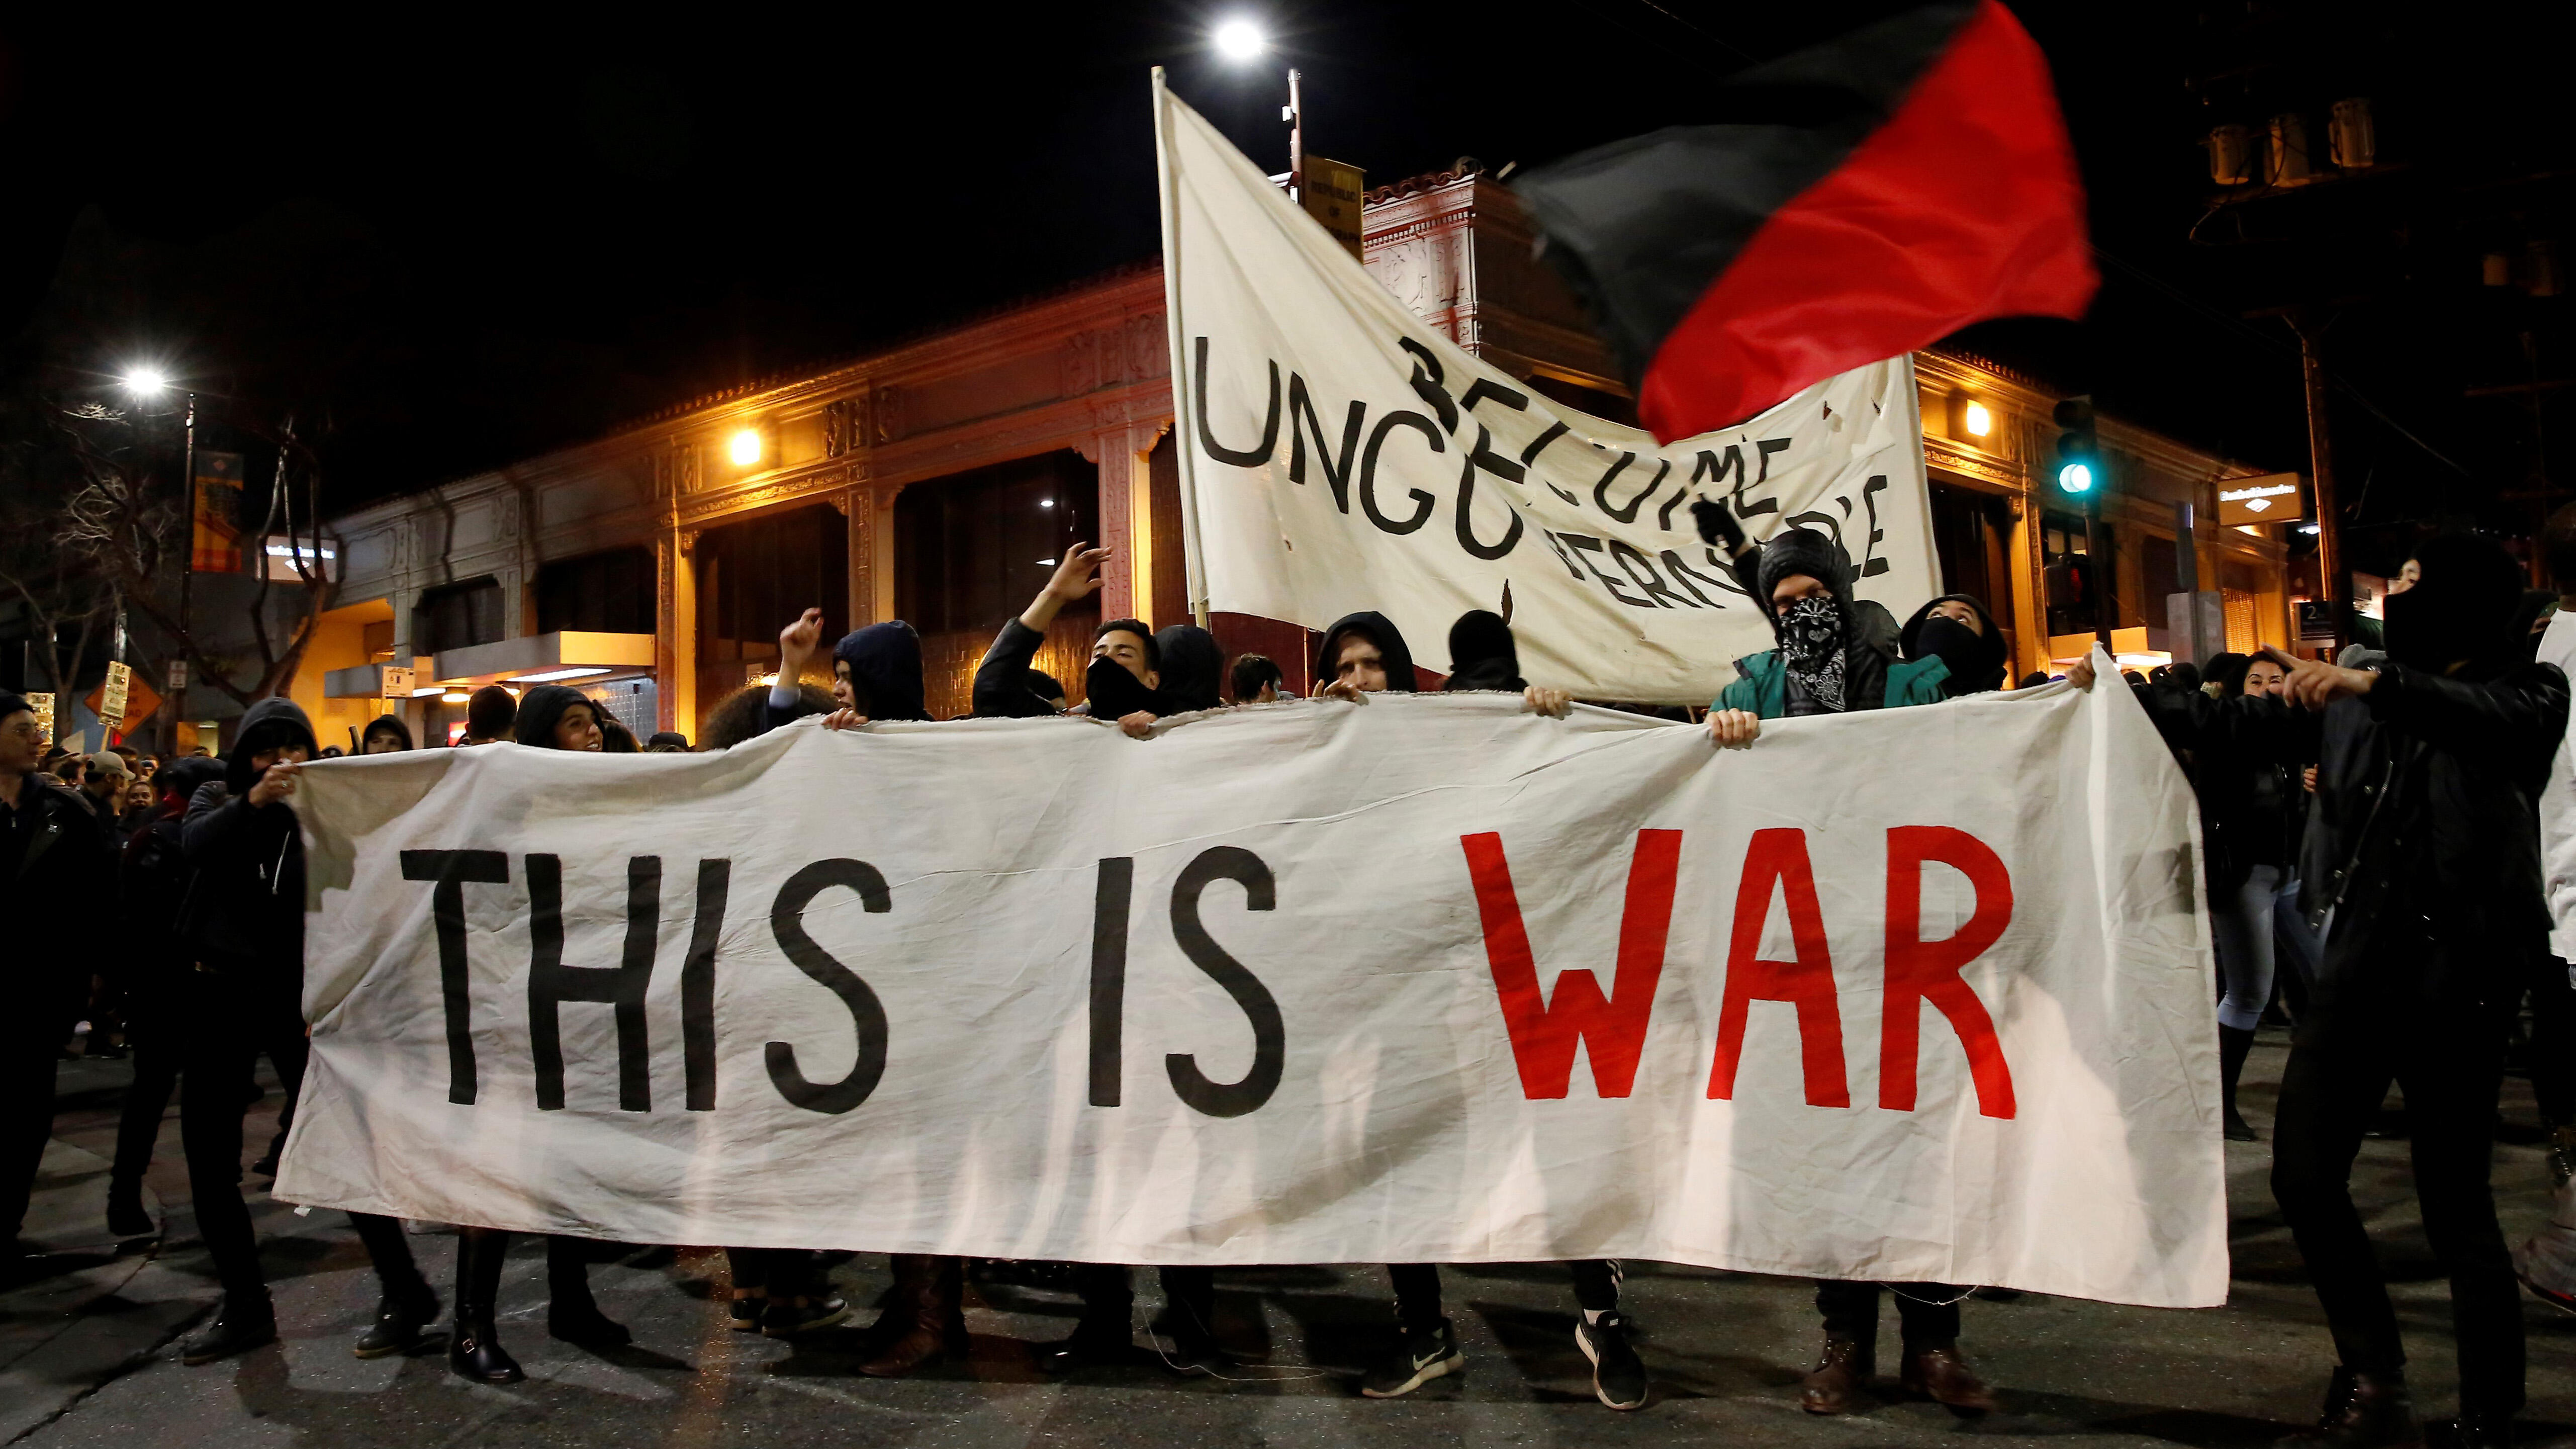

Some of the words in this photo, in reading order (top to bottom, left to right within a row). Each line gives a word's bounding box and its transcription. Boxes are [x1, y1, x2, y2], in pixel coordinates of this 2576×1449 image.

[400, 849, 892, 1115] THIS
[1088, 846, 1285, 1118] IS
[1460, 826, 2017, 1120] WAR
